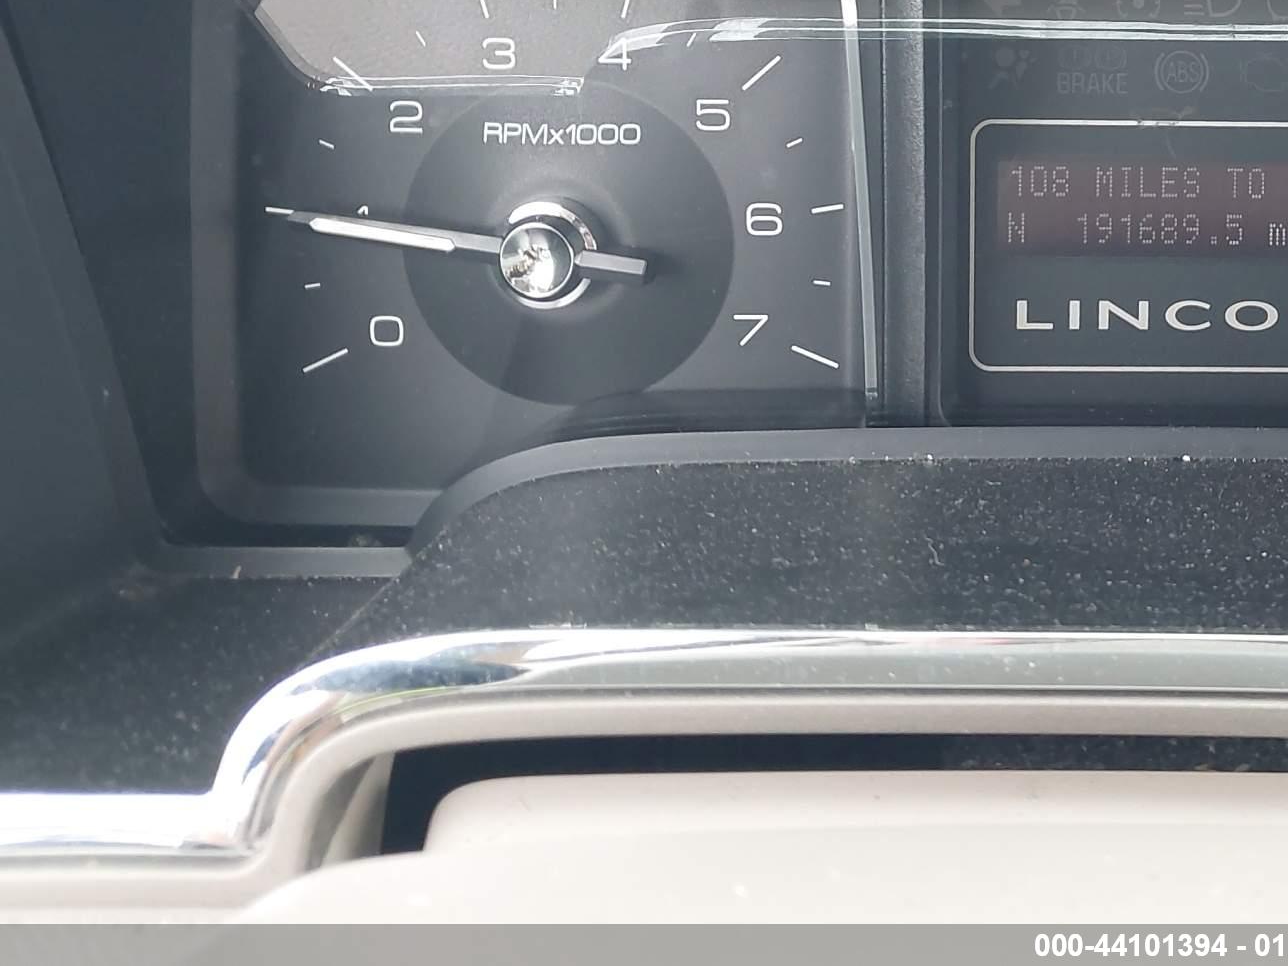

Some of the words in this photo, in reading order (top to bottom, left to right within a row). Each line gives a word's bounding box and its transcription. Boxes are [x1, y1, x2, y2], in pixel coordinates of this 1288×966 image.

[482, 38, 516, 70] 3
[599, 38, 632, 70] 4
[1057, 73, 1128, 94] BRAKE
[1166, 62, 1198, 83] ABS
[389, 100, 423, 134] 2
[695, 99, 731, 131] 5
[483, 121, 641, 145] RPMx1000
[1012, 166, 1070, 197] 108
[1096, 166, 1199, 198] MILES
[1227, 168, 1264, 198] TO
[745, 202, 783, 236] 6
[1008, 212, 1025, 243] N
[1078, 213, 1243, 244] 191689.5
[369, 315, 404, 347] 0
[733, 314, 769, 347] 7
